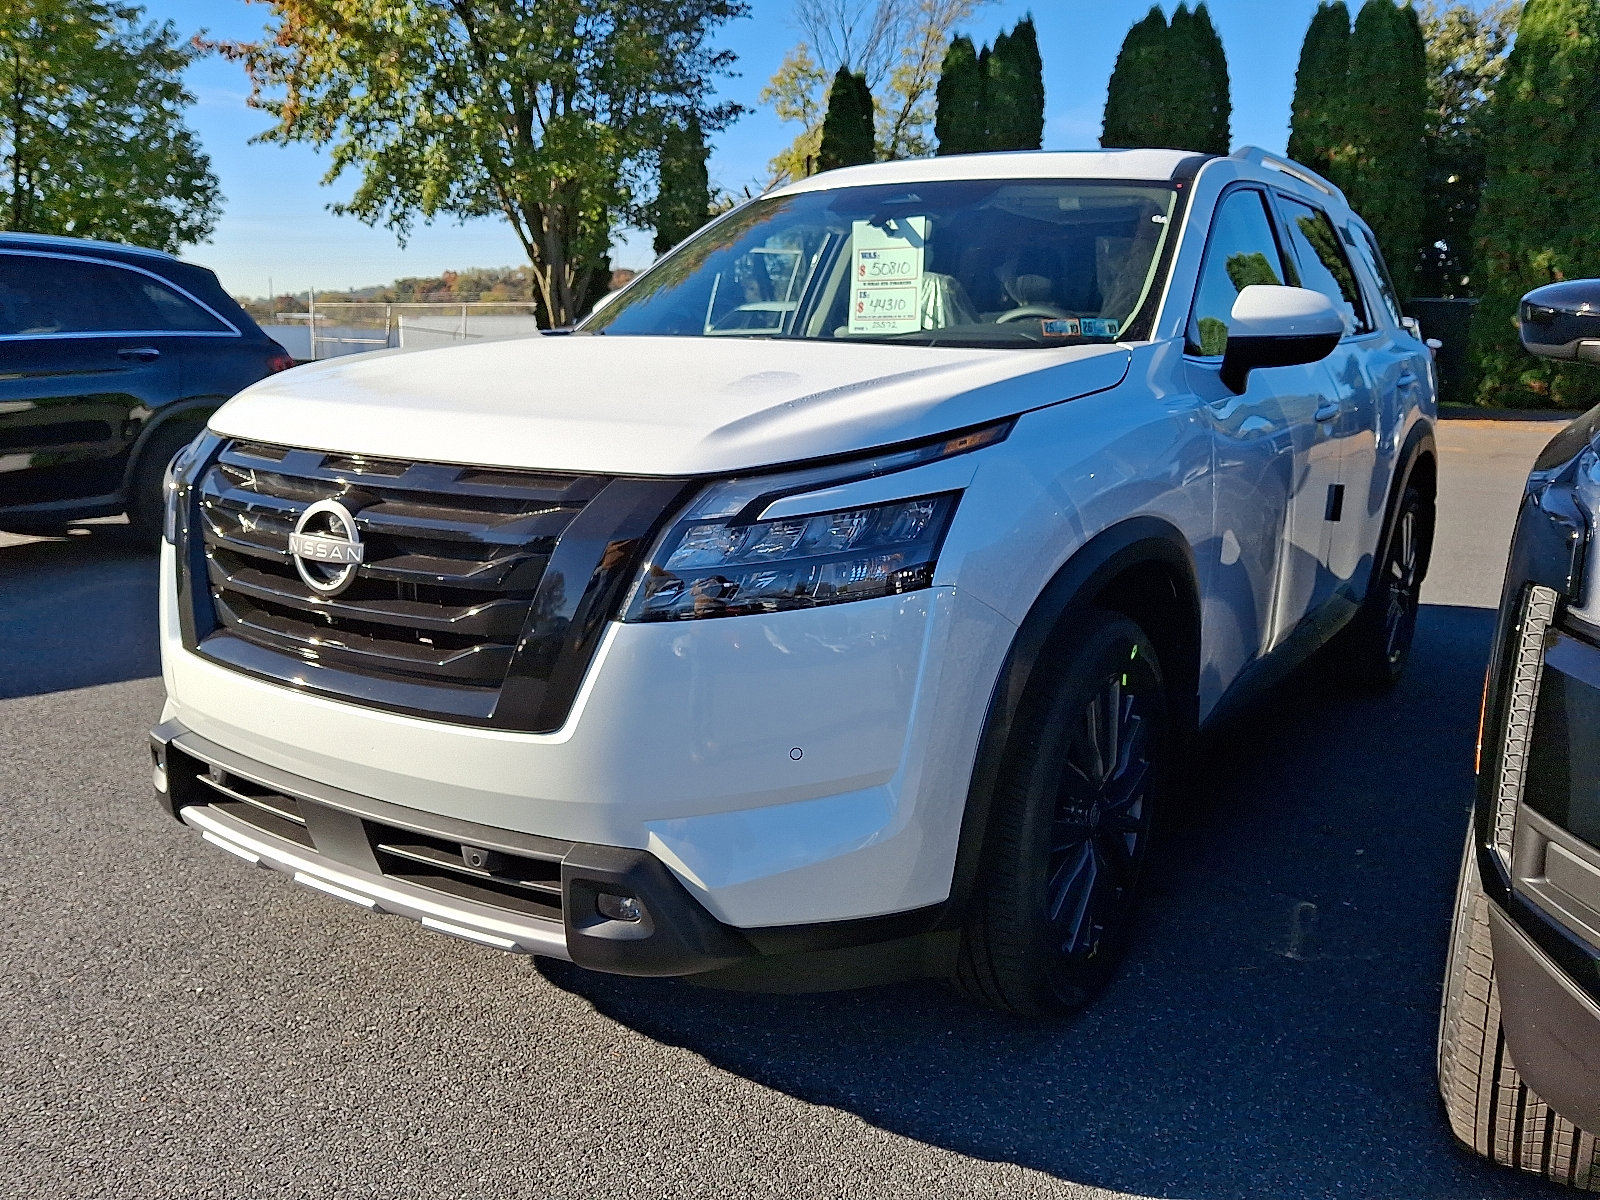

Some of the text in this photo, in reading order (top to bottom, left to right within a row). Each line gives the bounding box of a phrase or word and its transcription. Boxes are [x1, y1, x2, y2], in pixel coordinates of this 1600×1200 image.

[860, 262, 911, 277] $ 50810
[858, 298, 906, 313] $ 44310
[290, 536, 362, 562] NISSAN
